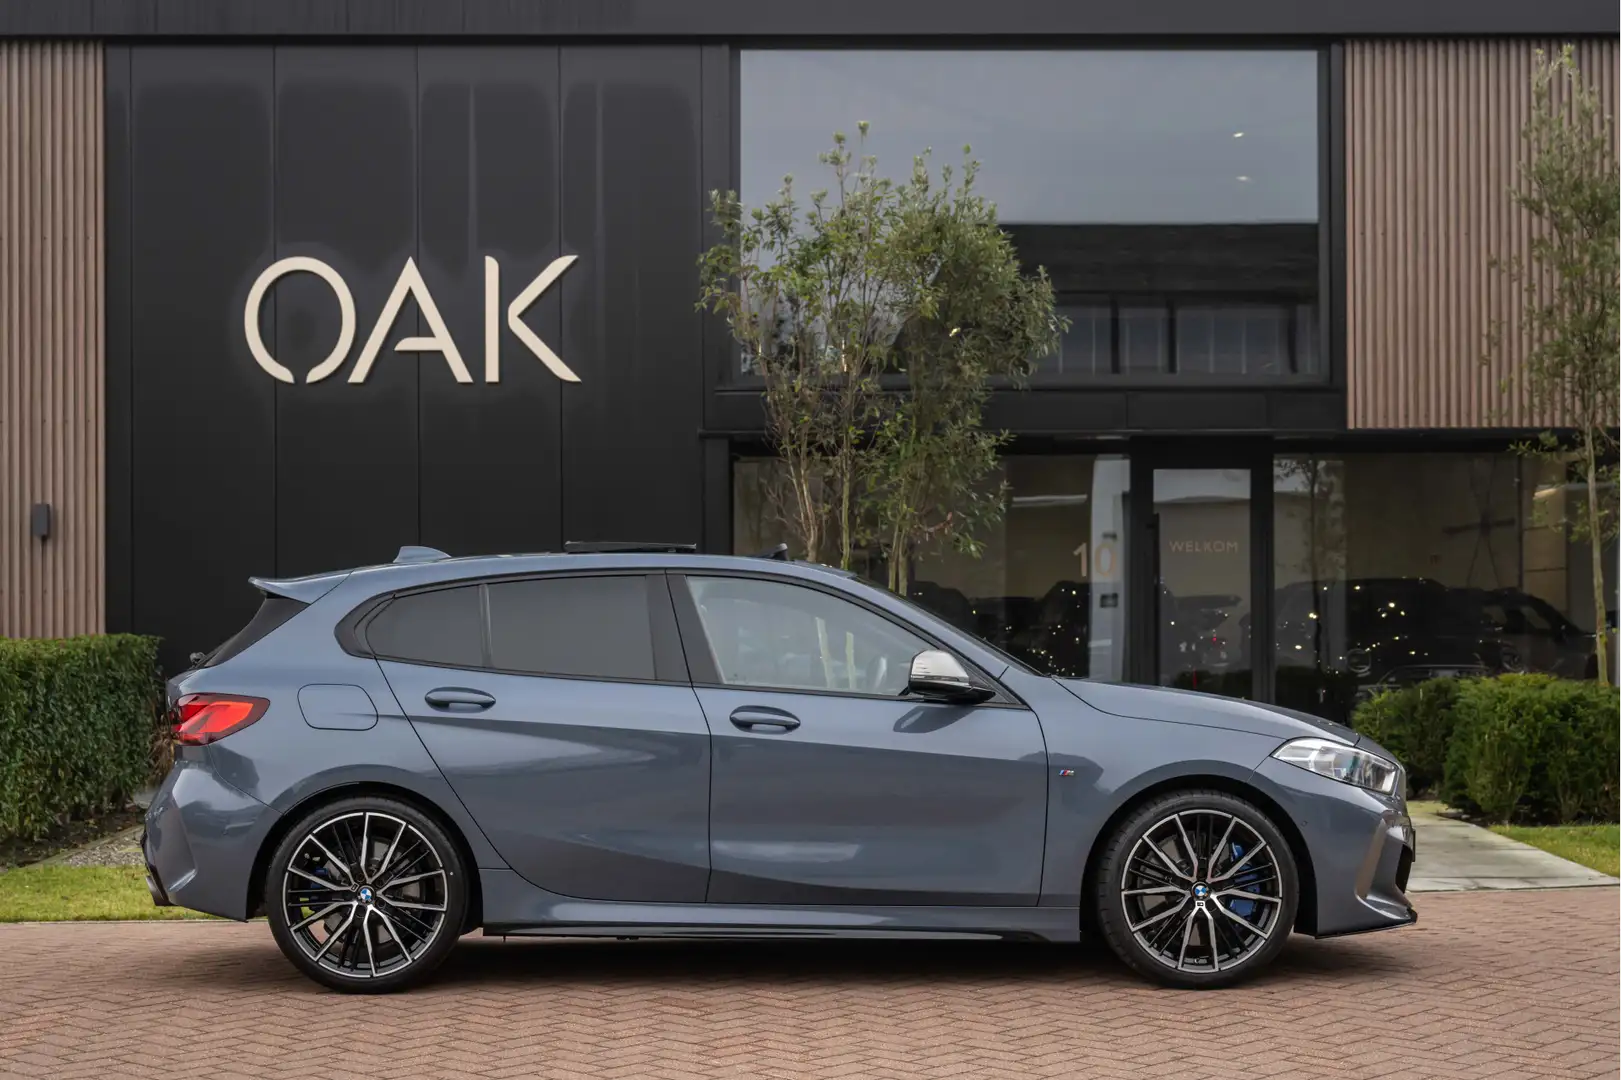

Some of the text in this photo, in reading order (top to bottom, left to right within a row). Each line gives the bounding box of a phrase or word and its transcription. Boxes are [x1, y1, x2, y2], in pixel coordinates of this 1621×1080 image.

[244, 254, 582, 384] OAK
[1073, 541, 1117, 577] 10
[1169, 540, 1239, 554] WELKOM
